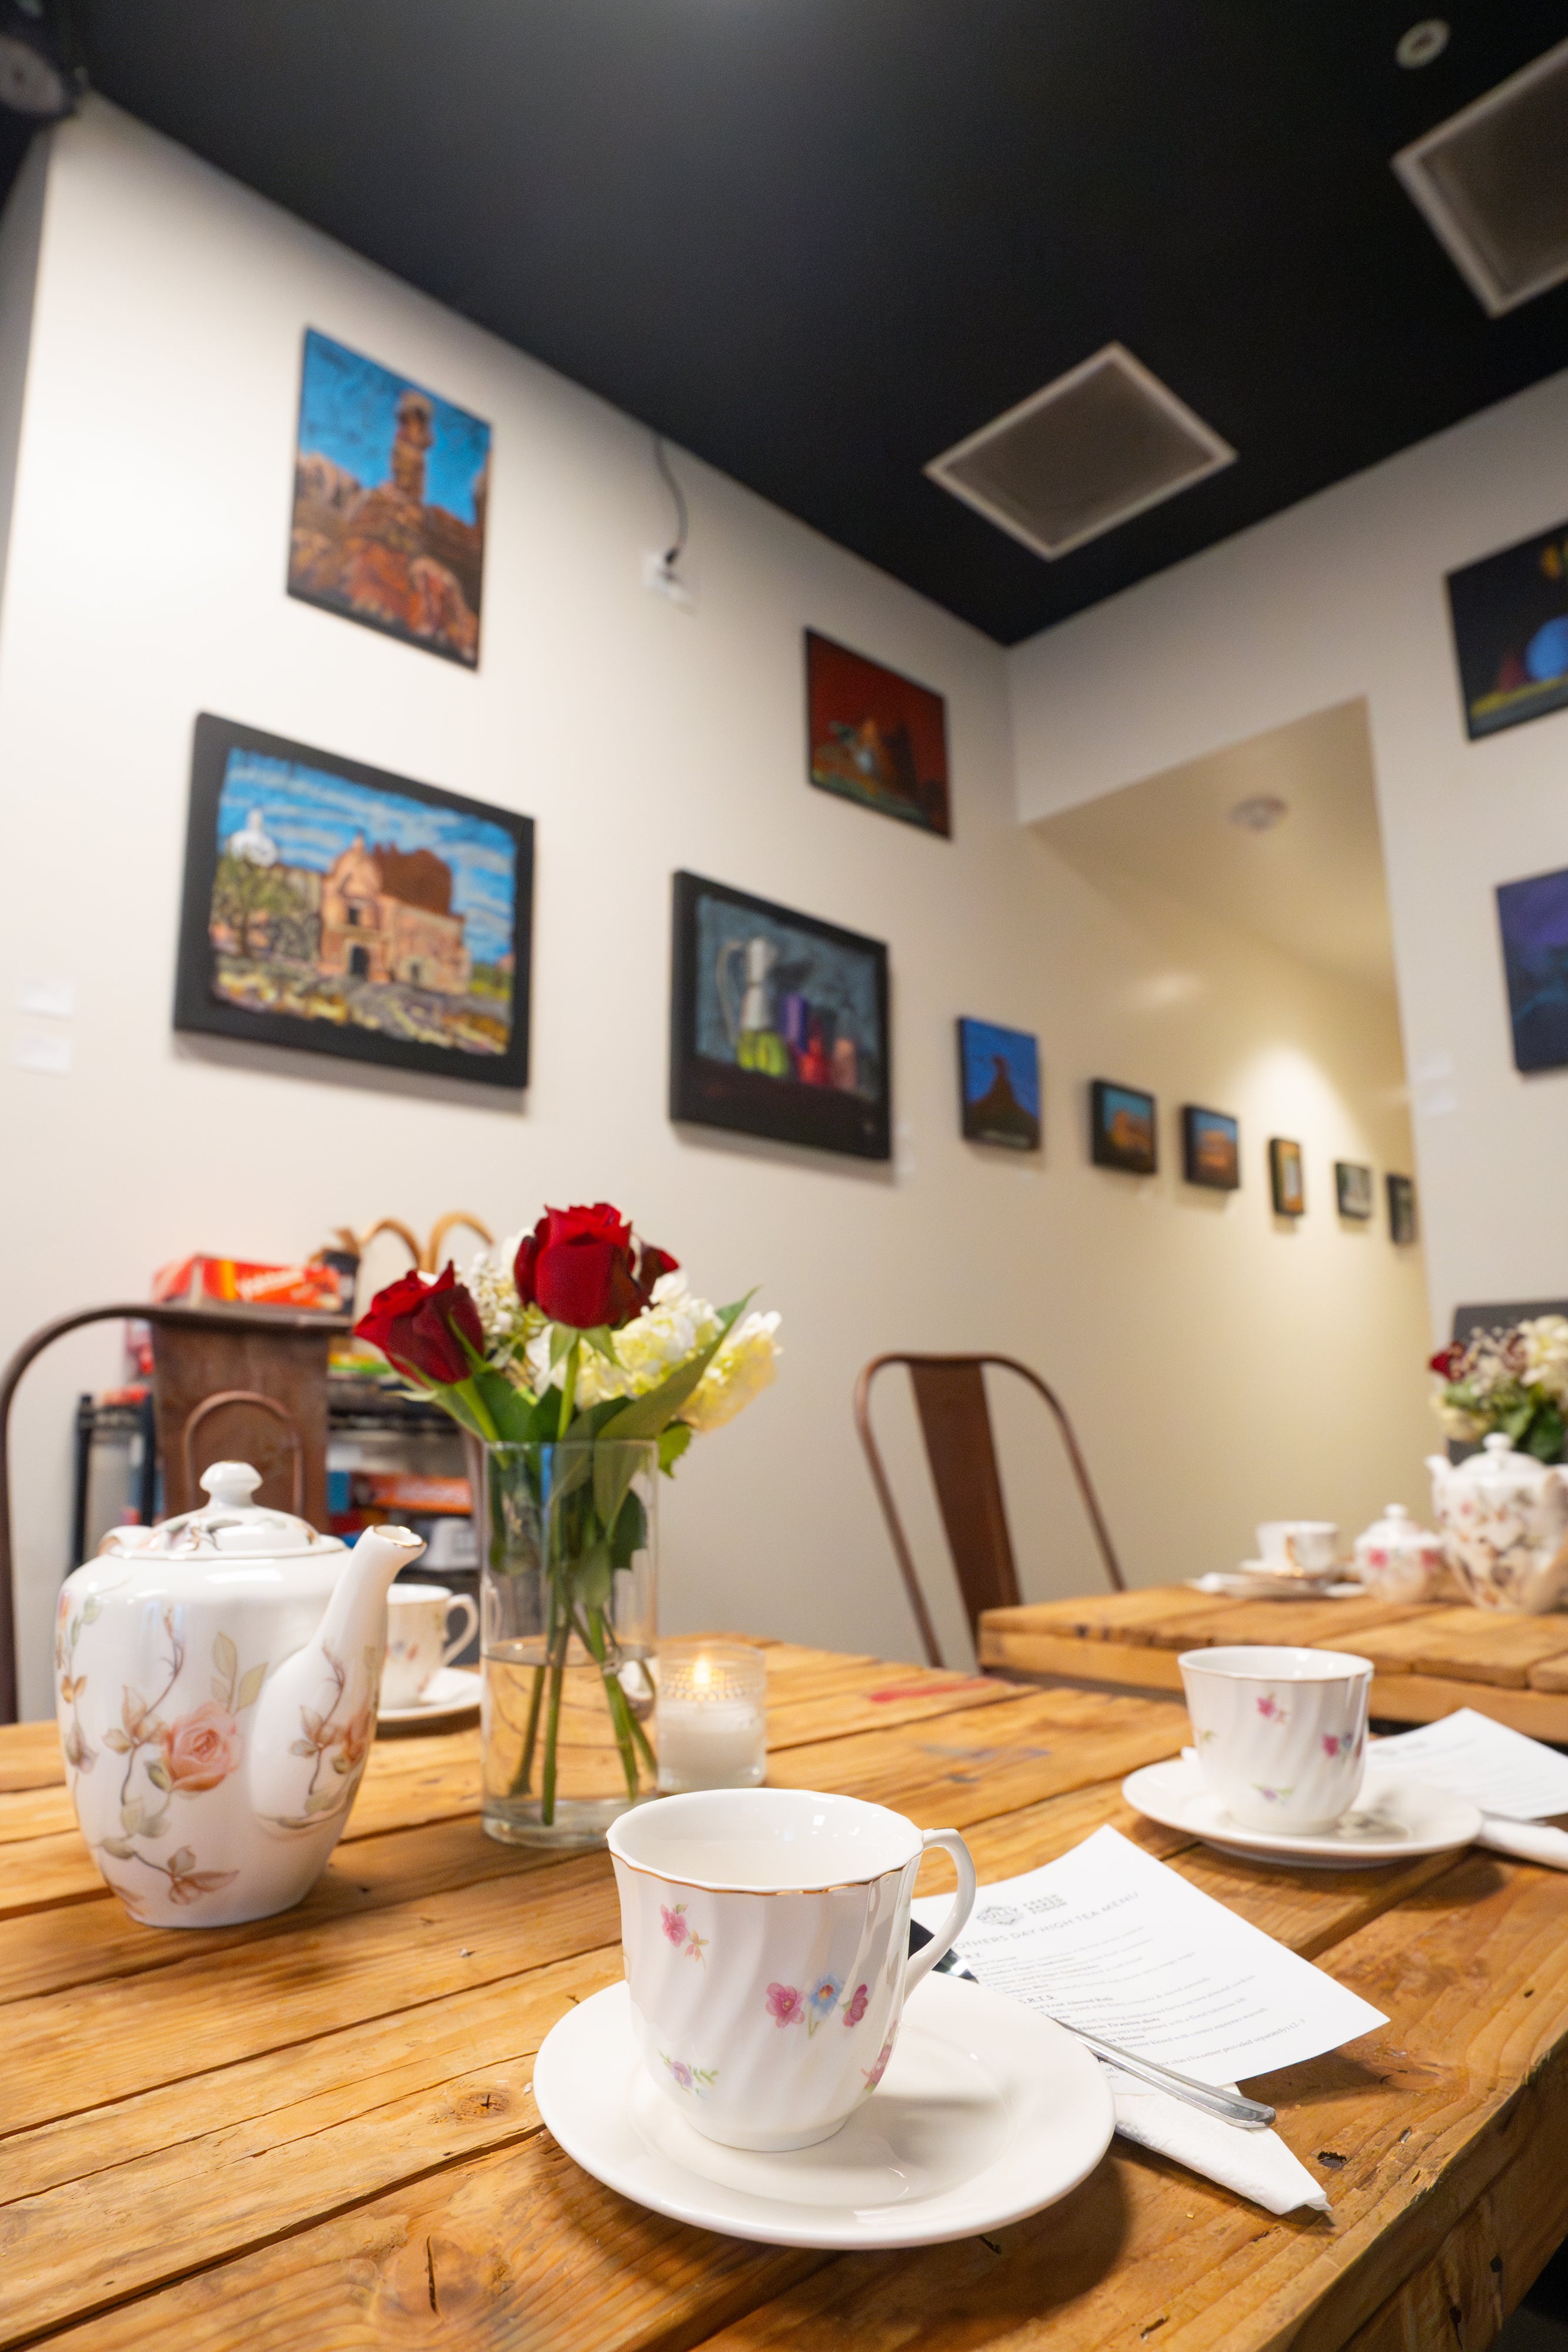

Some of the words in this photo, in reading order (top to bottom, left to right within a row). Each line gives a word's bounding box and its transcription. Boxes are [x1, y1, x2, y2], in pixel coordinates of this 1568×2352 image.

[954, 1934, 1009, 1950] OTHERS
[1010, 1929, 1035, 1939] DAY
[1040, 1919, 1073, 1933] HIGH
[1075, 1910, 1101, 1921] TEA
[1101, 1890, 1139, 1913] MENU
[1171, 2057, 1186, 2065] chai
[1223, 2039, 1253, 2053] provided
